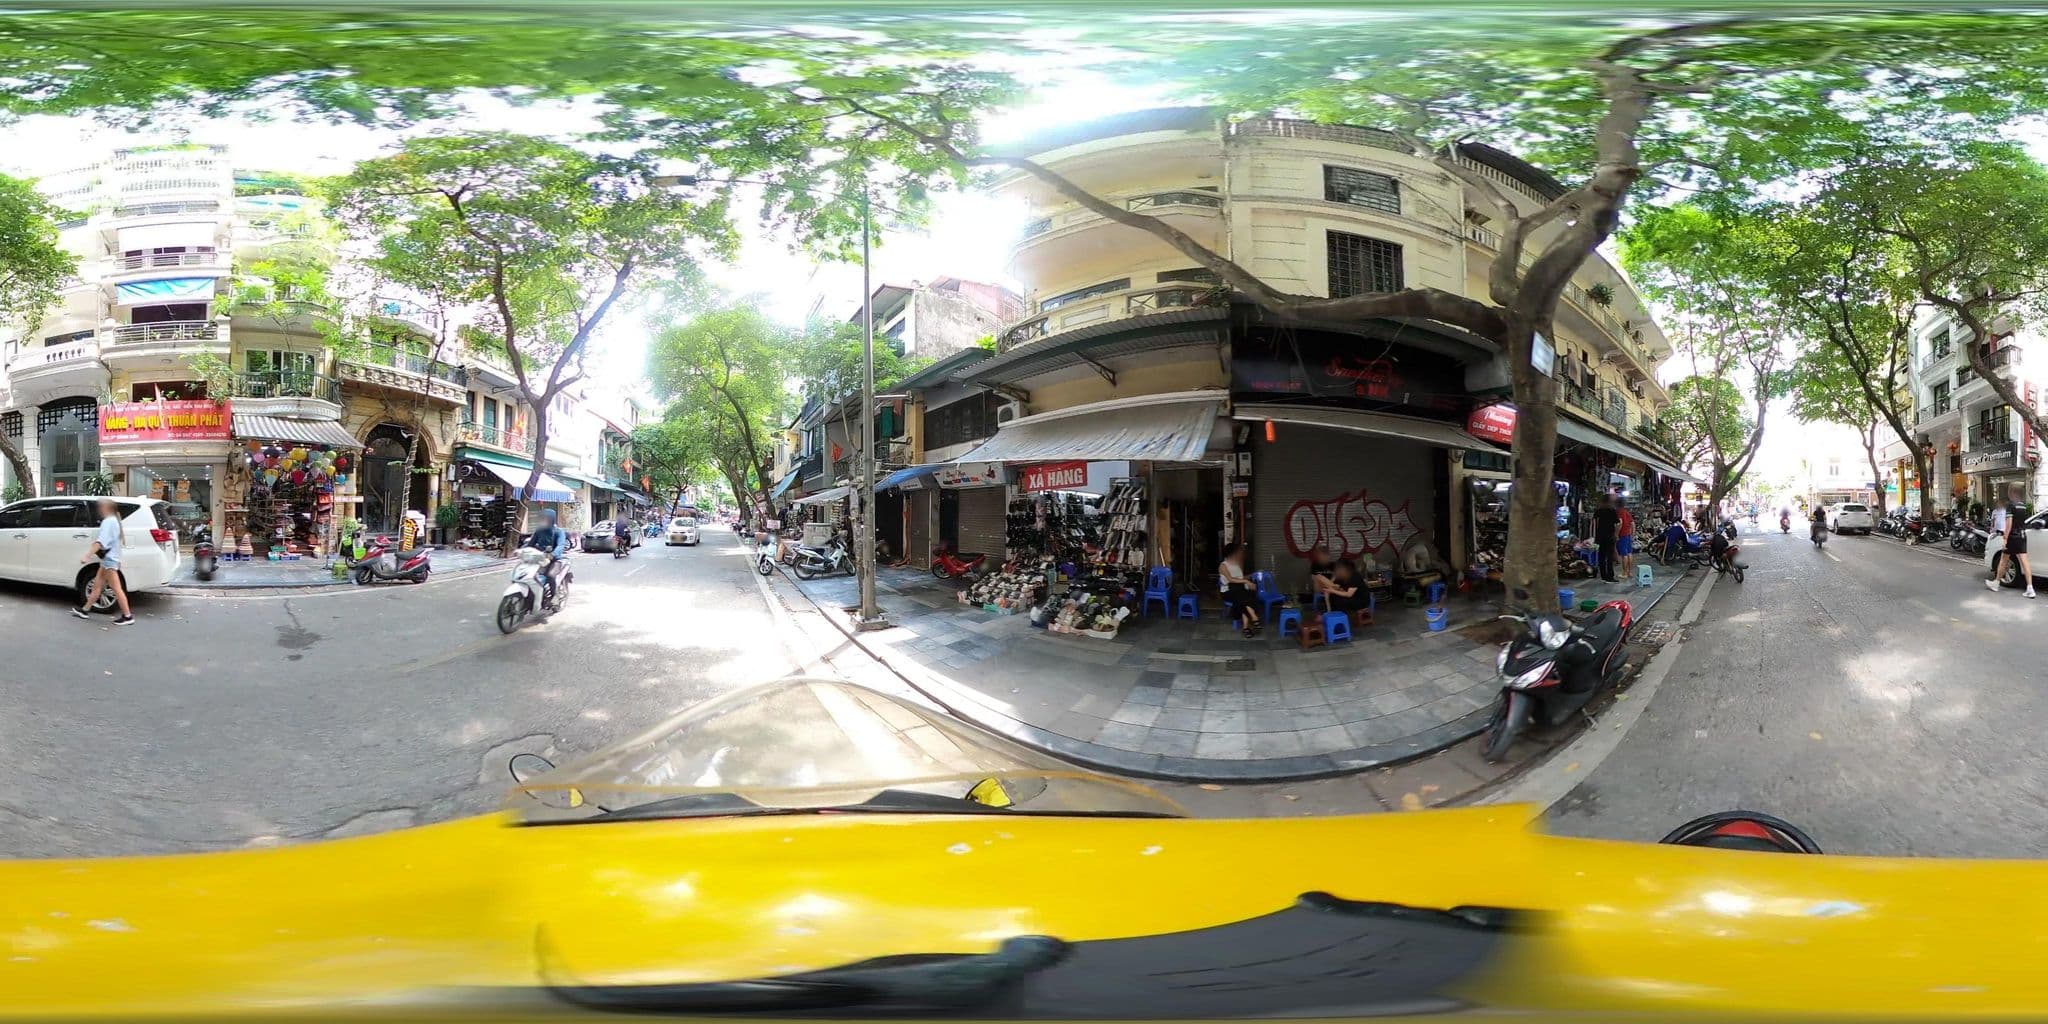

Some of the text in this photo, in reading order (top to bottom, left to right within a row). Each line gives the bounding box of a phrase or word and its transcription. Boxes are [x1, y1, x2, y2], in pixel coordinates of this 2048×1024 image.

[200, 412, 224, 426] PHÁT
[1029, 467, 1083, 488] XẢ HÀNG
